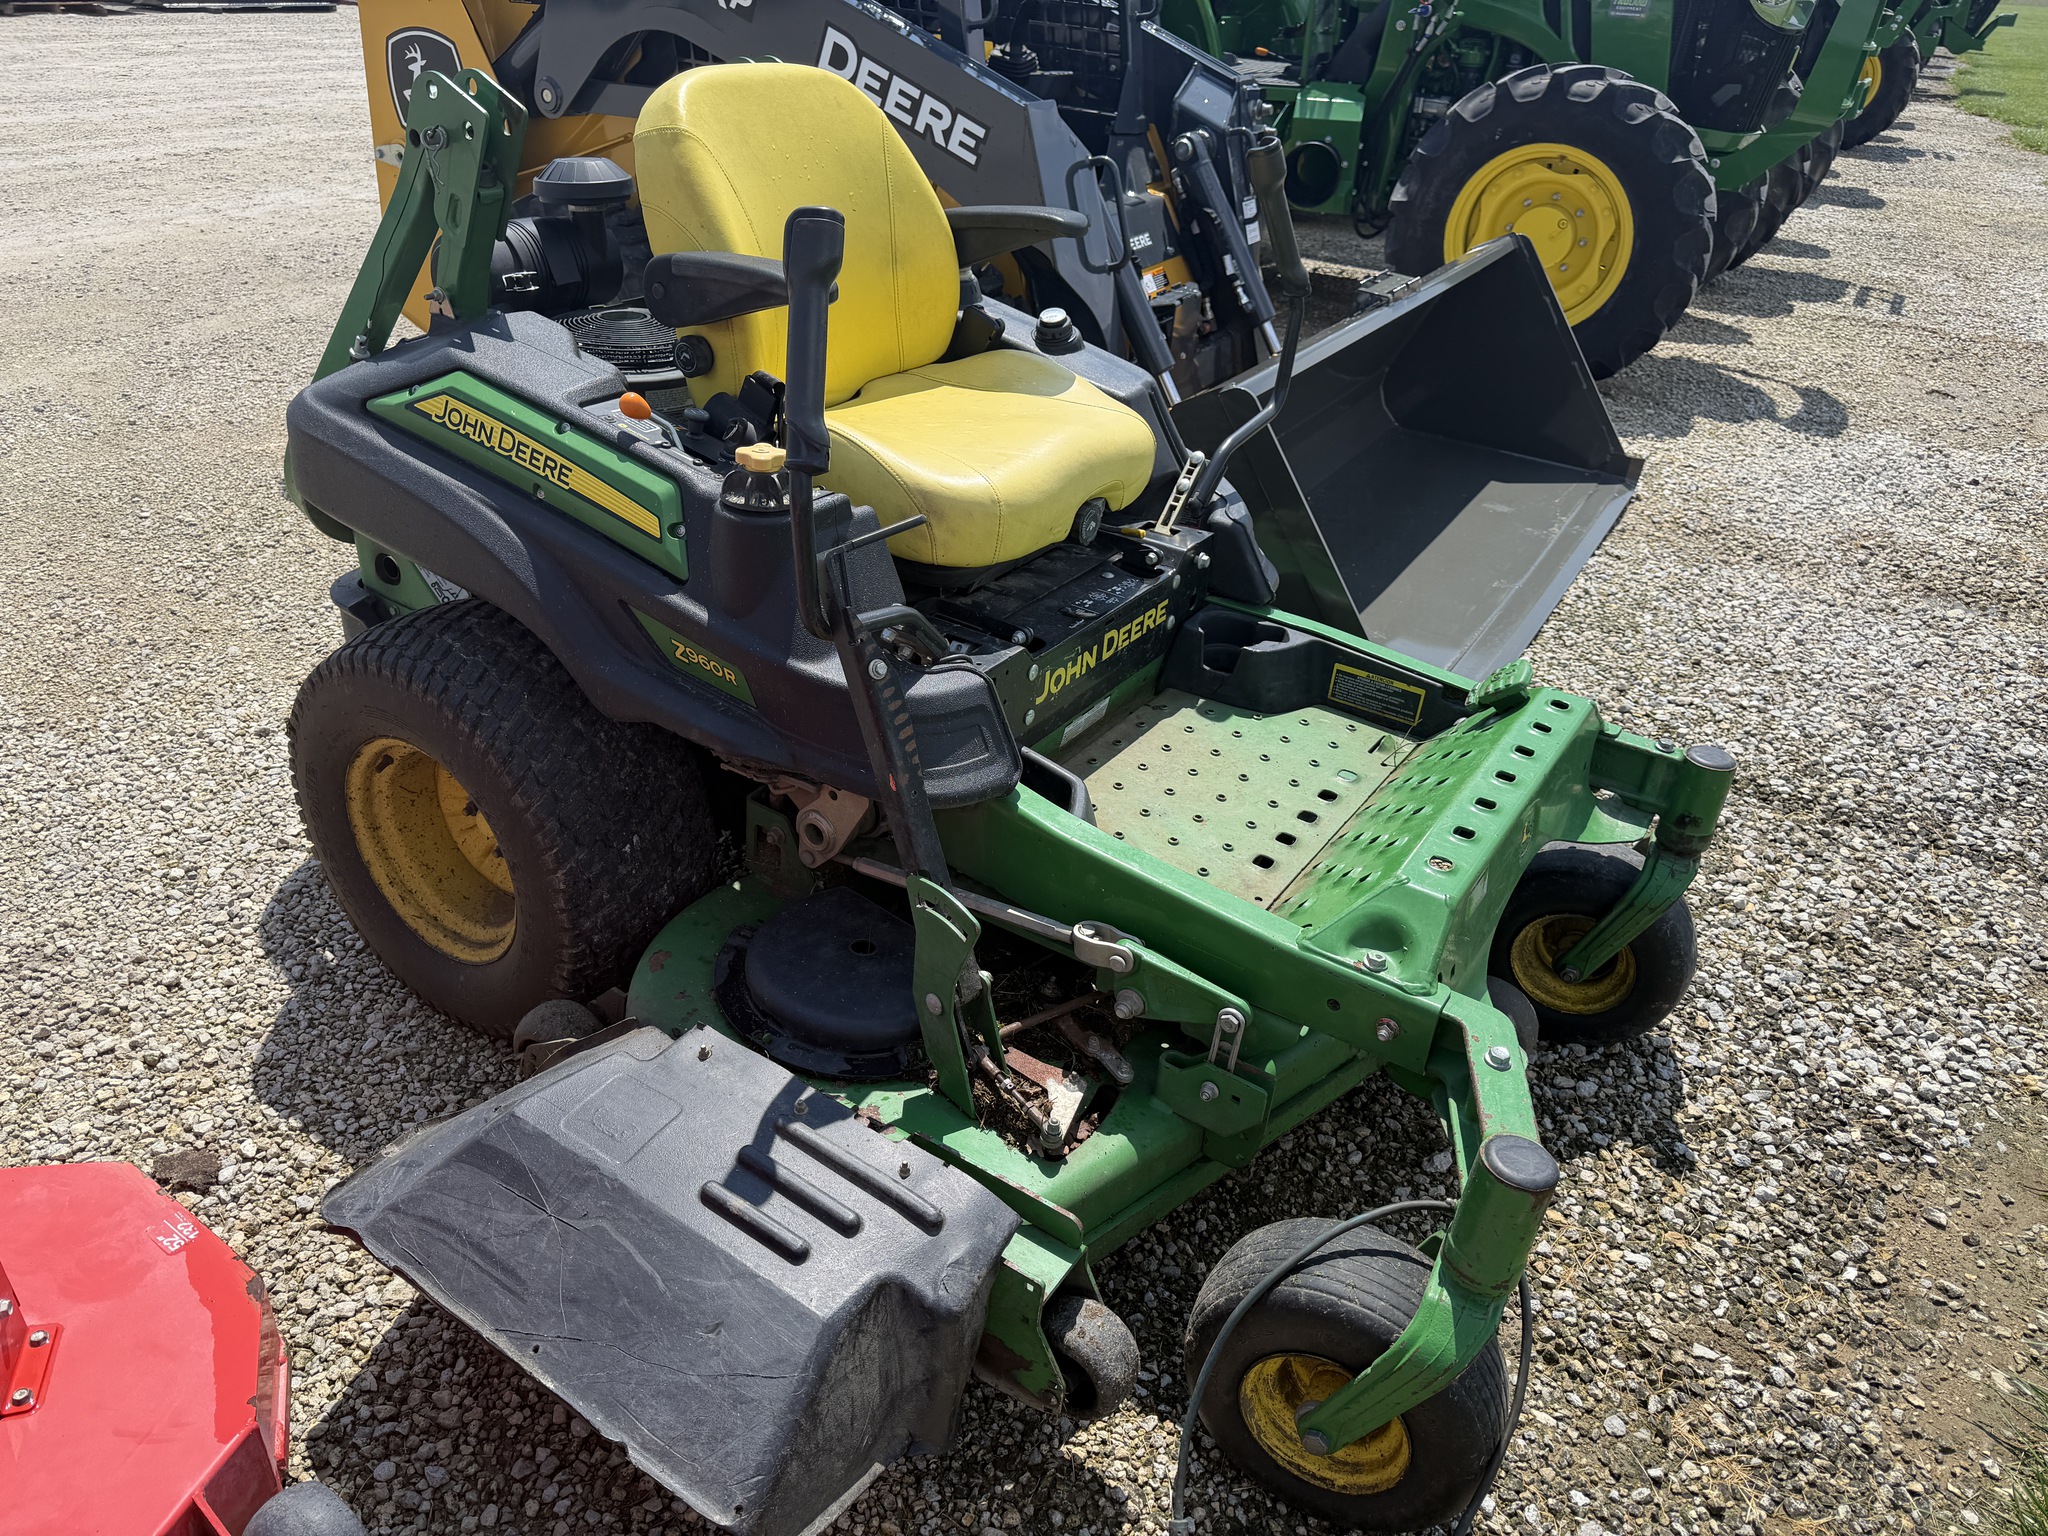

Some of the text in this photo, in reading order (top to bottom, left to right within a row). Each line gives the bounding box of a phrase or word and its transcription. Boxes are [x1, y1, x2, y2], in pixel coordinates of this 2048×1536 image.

[818, 25, 986, 166] DEERE
[1129, 231, 1152, 250] EERE
[433, 399, 573, 488] JOHN DEERE
[670, 637, 738, 687] Z960R
[1035, 644, 1098, 705] JOHN
[1101, 598, 1169, 662] DEERE
